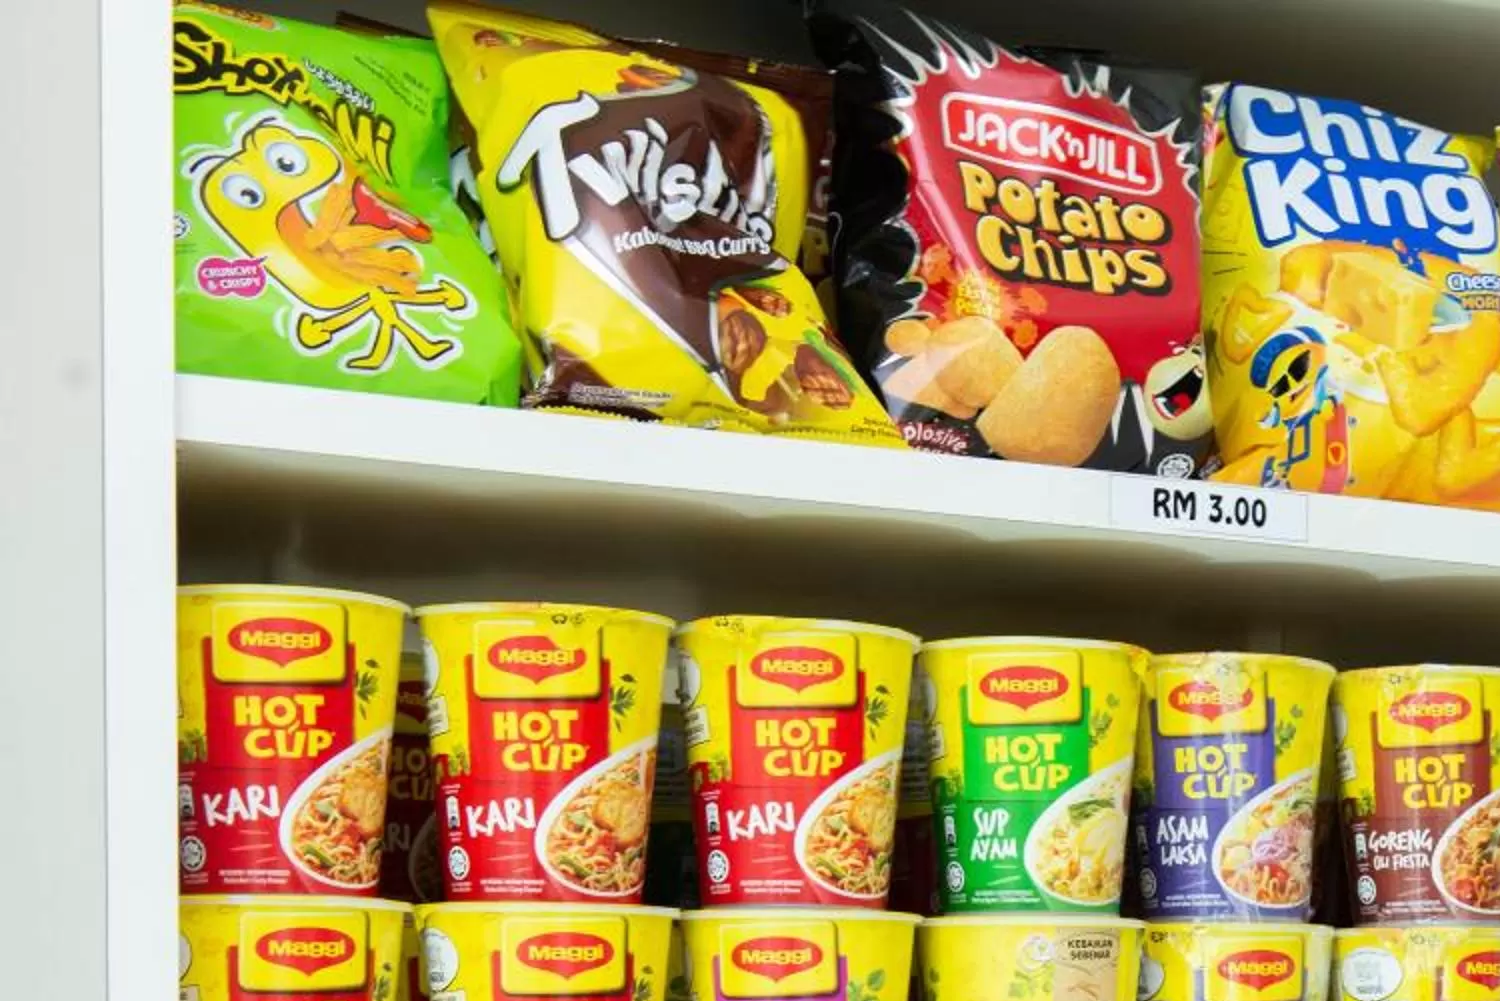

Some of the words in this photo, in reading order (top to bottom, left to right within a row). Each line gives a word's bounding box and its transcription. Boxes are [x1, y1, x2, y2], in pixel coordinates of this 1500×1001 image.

[1227, 82, 1469, 171] Chiz
[959, 161, 1169, 242] Potato
[1246, 156, 1498, 252] King
[975, 214, 1171, 295] Chips
[1151, 487, 1198, 521] RM
[1207, 493, 1268, 528] 3.00
[240, 629, 321, 650] Maggi
[498, 647, 576, 667] Maggi
[761, 658, 834, 677] Maggi
[989, 676, 1059, 694] Maggi
[232, 694, 325, 727] HOT
[491, 708, 580, 742] HOT
[243, 727, 334, 758] CUP
[755, 716, 838, 749] HOT
[985, 732, 1063, 764] HOT
[502, 741, 588, 772] CUP
[763, 747, 845, 778] CUP
[1174, 743, 1248, 773] HOT
[1394, 753, 1466, 784] HOT
[993, 762, 1071, 792] CUP
[1182, 771, 1256, 800] CUP
[203, 784, 282, 828] KARI
[1402, 781, 1473, 809] CUP
[466, 796, 537, 839] KARI
[726, 801, 796, 842] KARI
[973, 806, 1011, 837] SUP
[1156, 814, 1209, 845] ASAM
[970, 837, 1018, 862] AYAM
[1160, 843, 1208, 867] LAKSA
[1368, 828, 1433, 853] GORENG
[1391, 853, 1431, 871] FIESTA
[267, 938, 346, 958] Maggi
[527, 943, 606, 963] Maggi
[740, 947, 813, 966] Maggi
